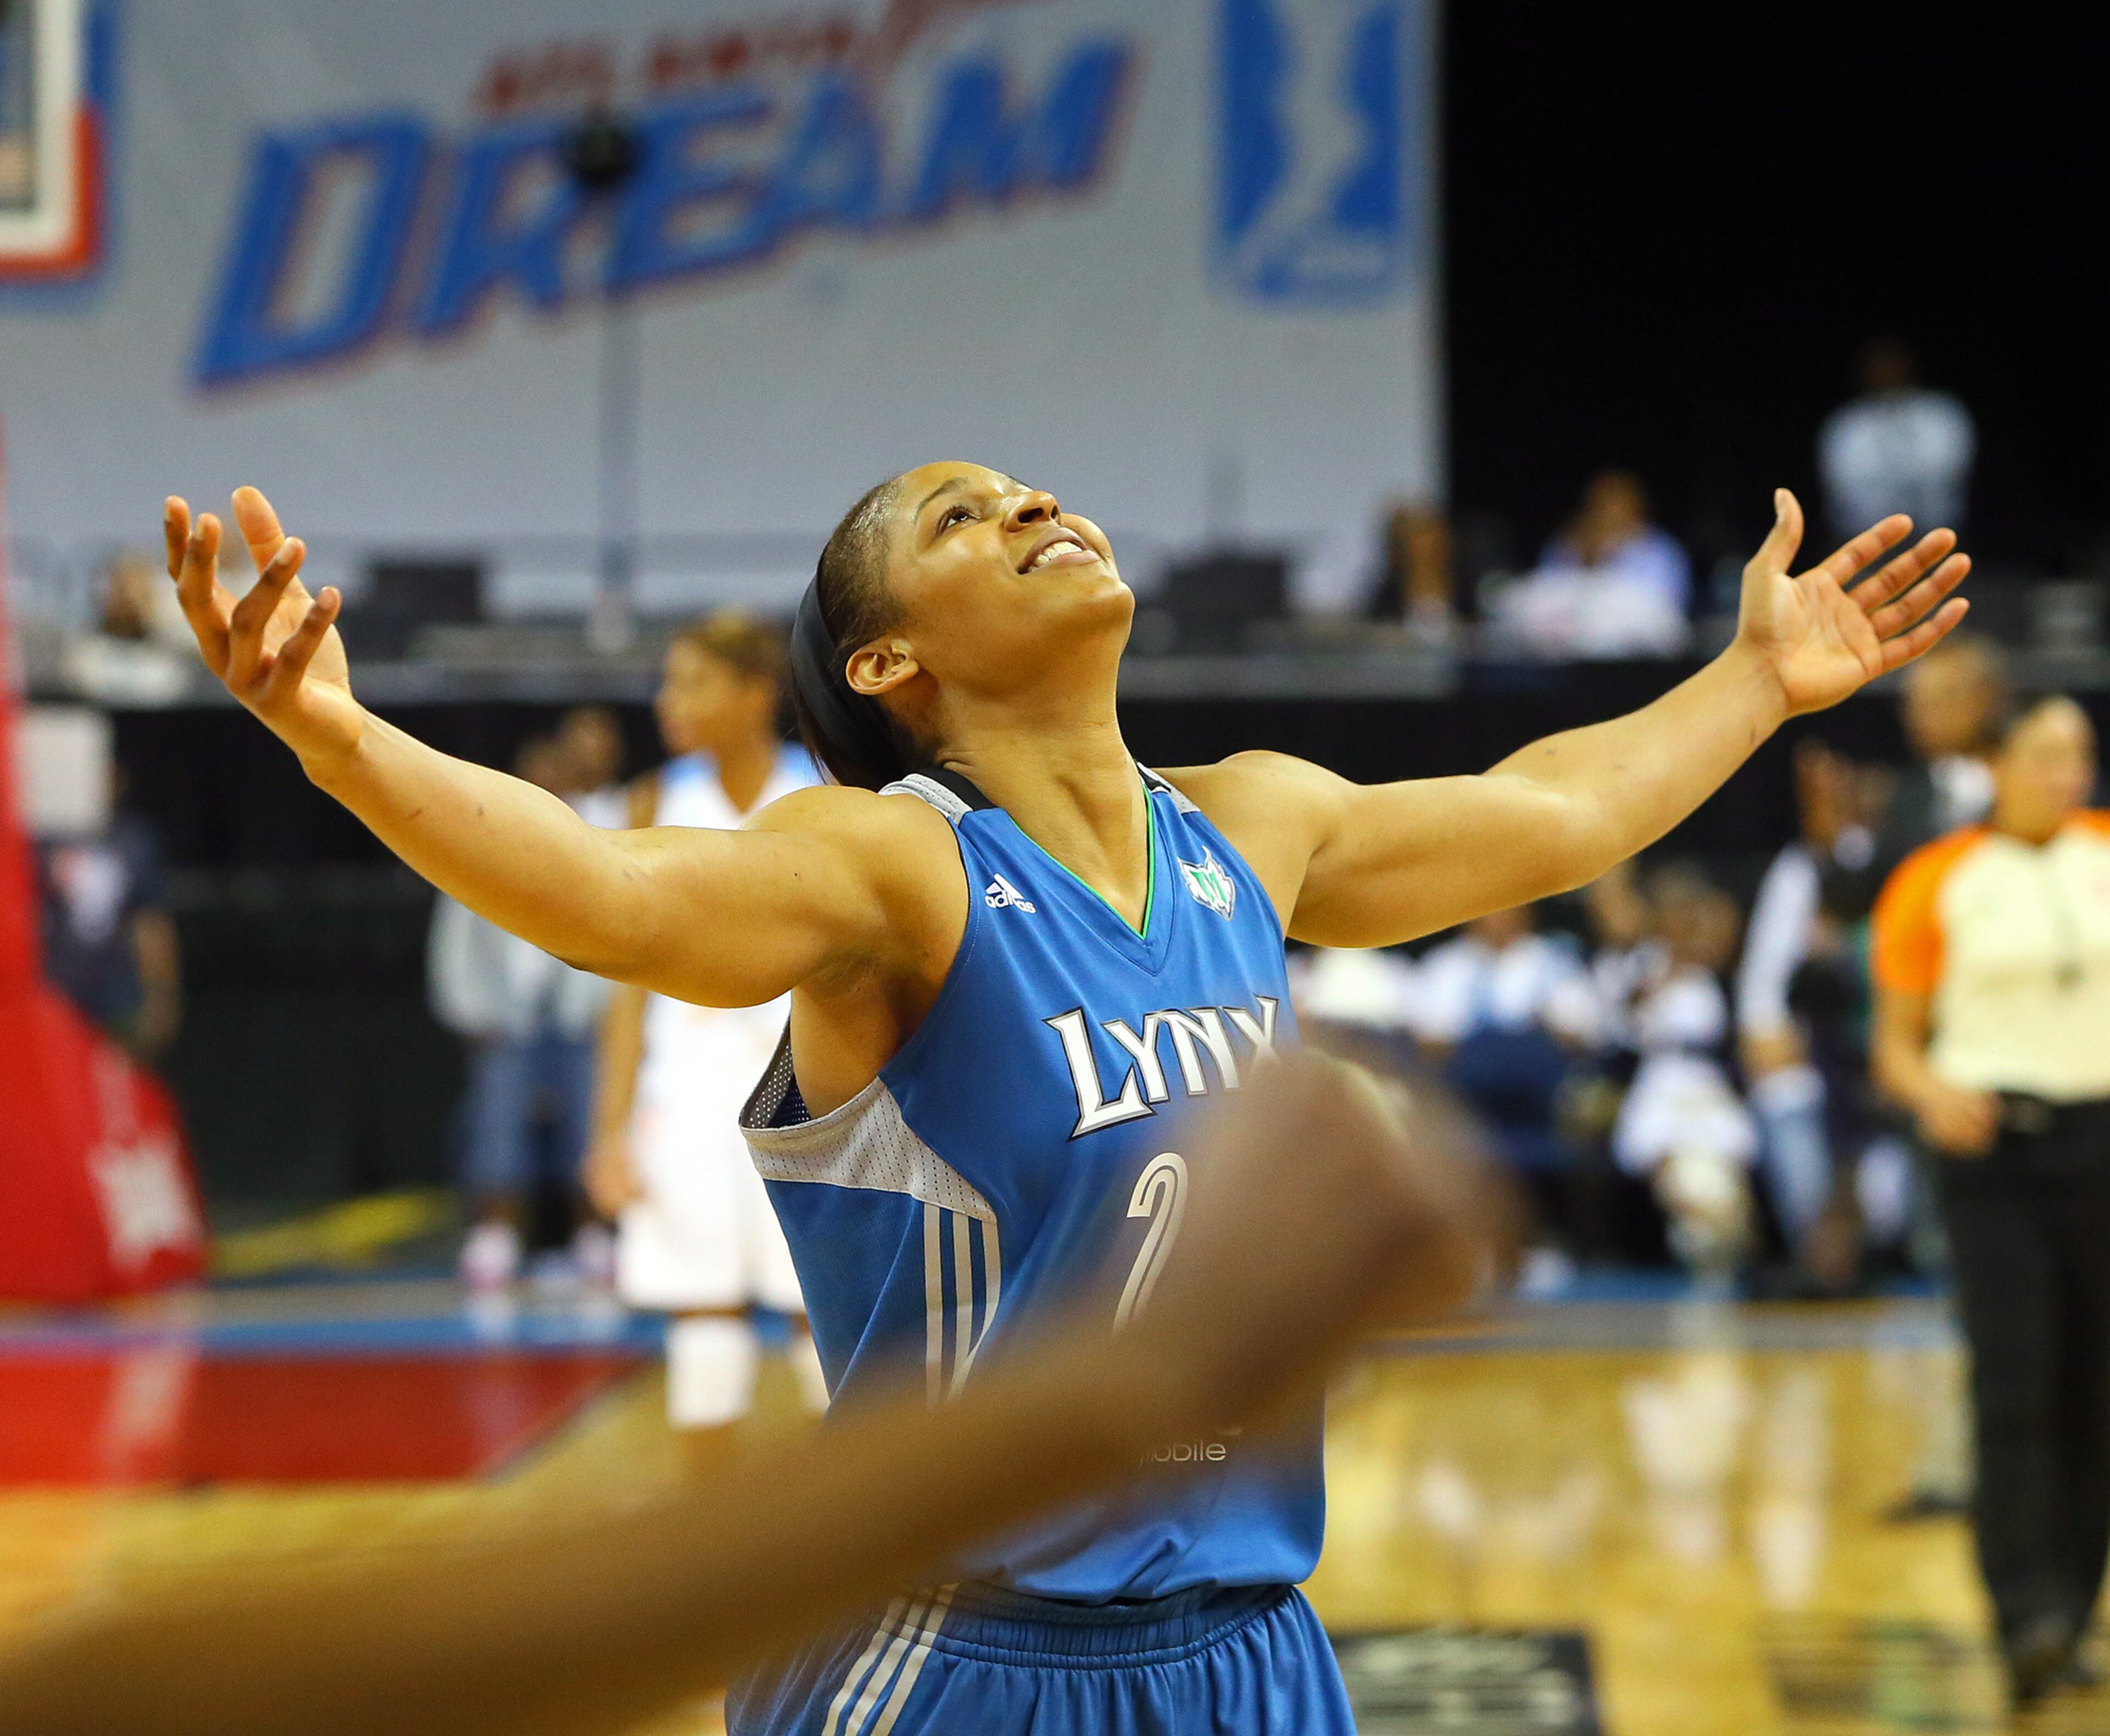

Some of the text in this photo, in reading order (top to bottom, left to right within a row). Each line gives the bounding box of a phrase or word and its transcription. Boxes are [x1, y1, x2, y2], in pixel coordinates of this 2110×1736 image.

[190, 34, 1142, 392] DREAM
[984, 889, 1037, 914] adias
[1112, 1151, 1188, 1332] 2
